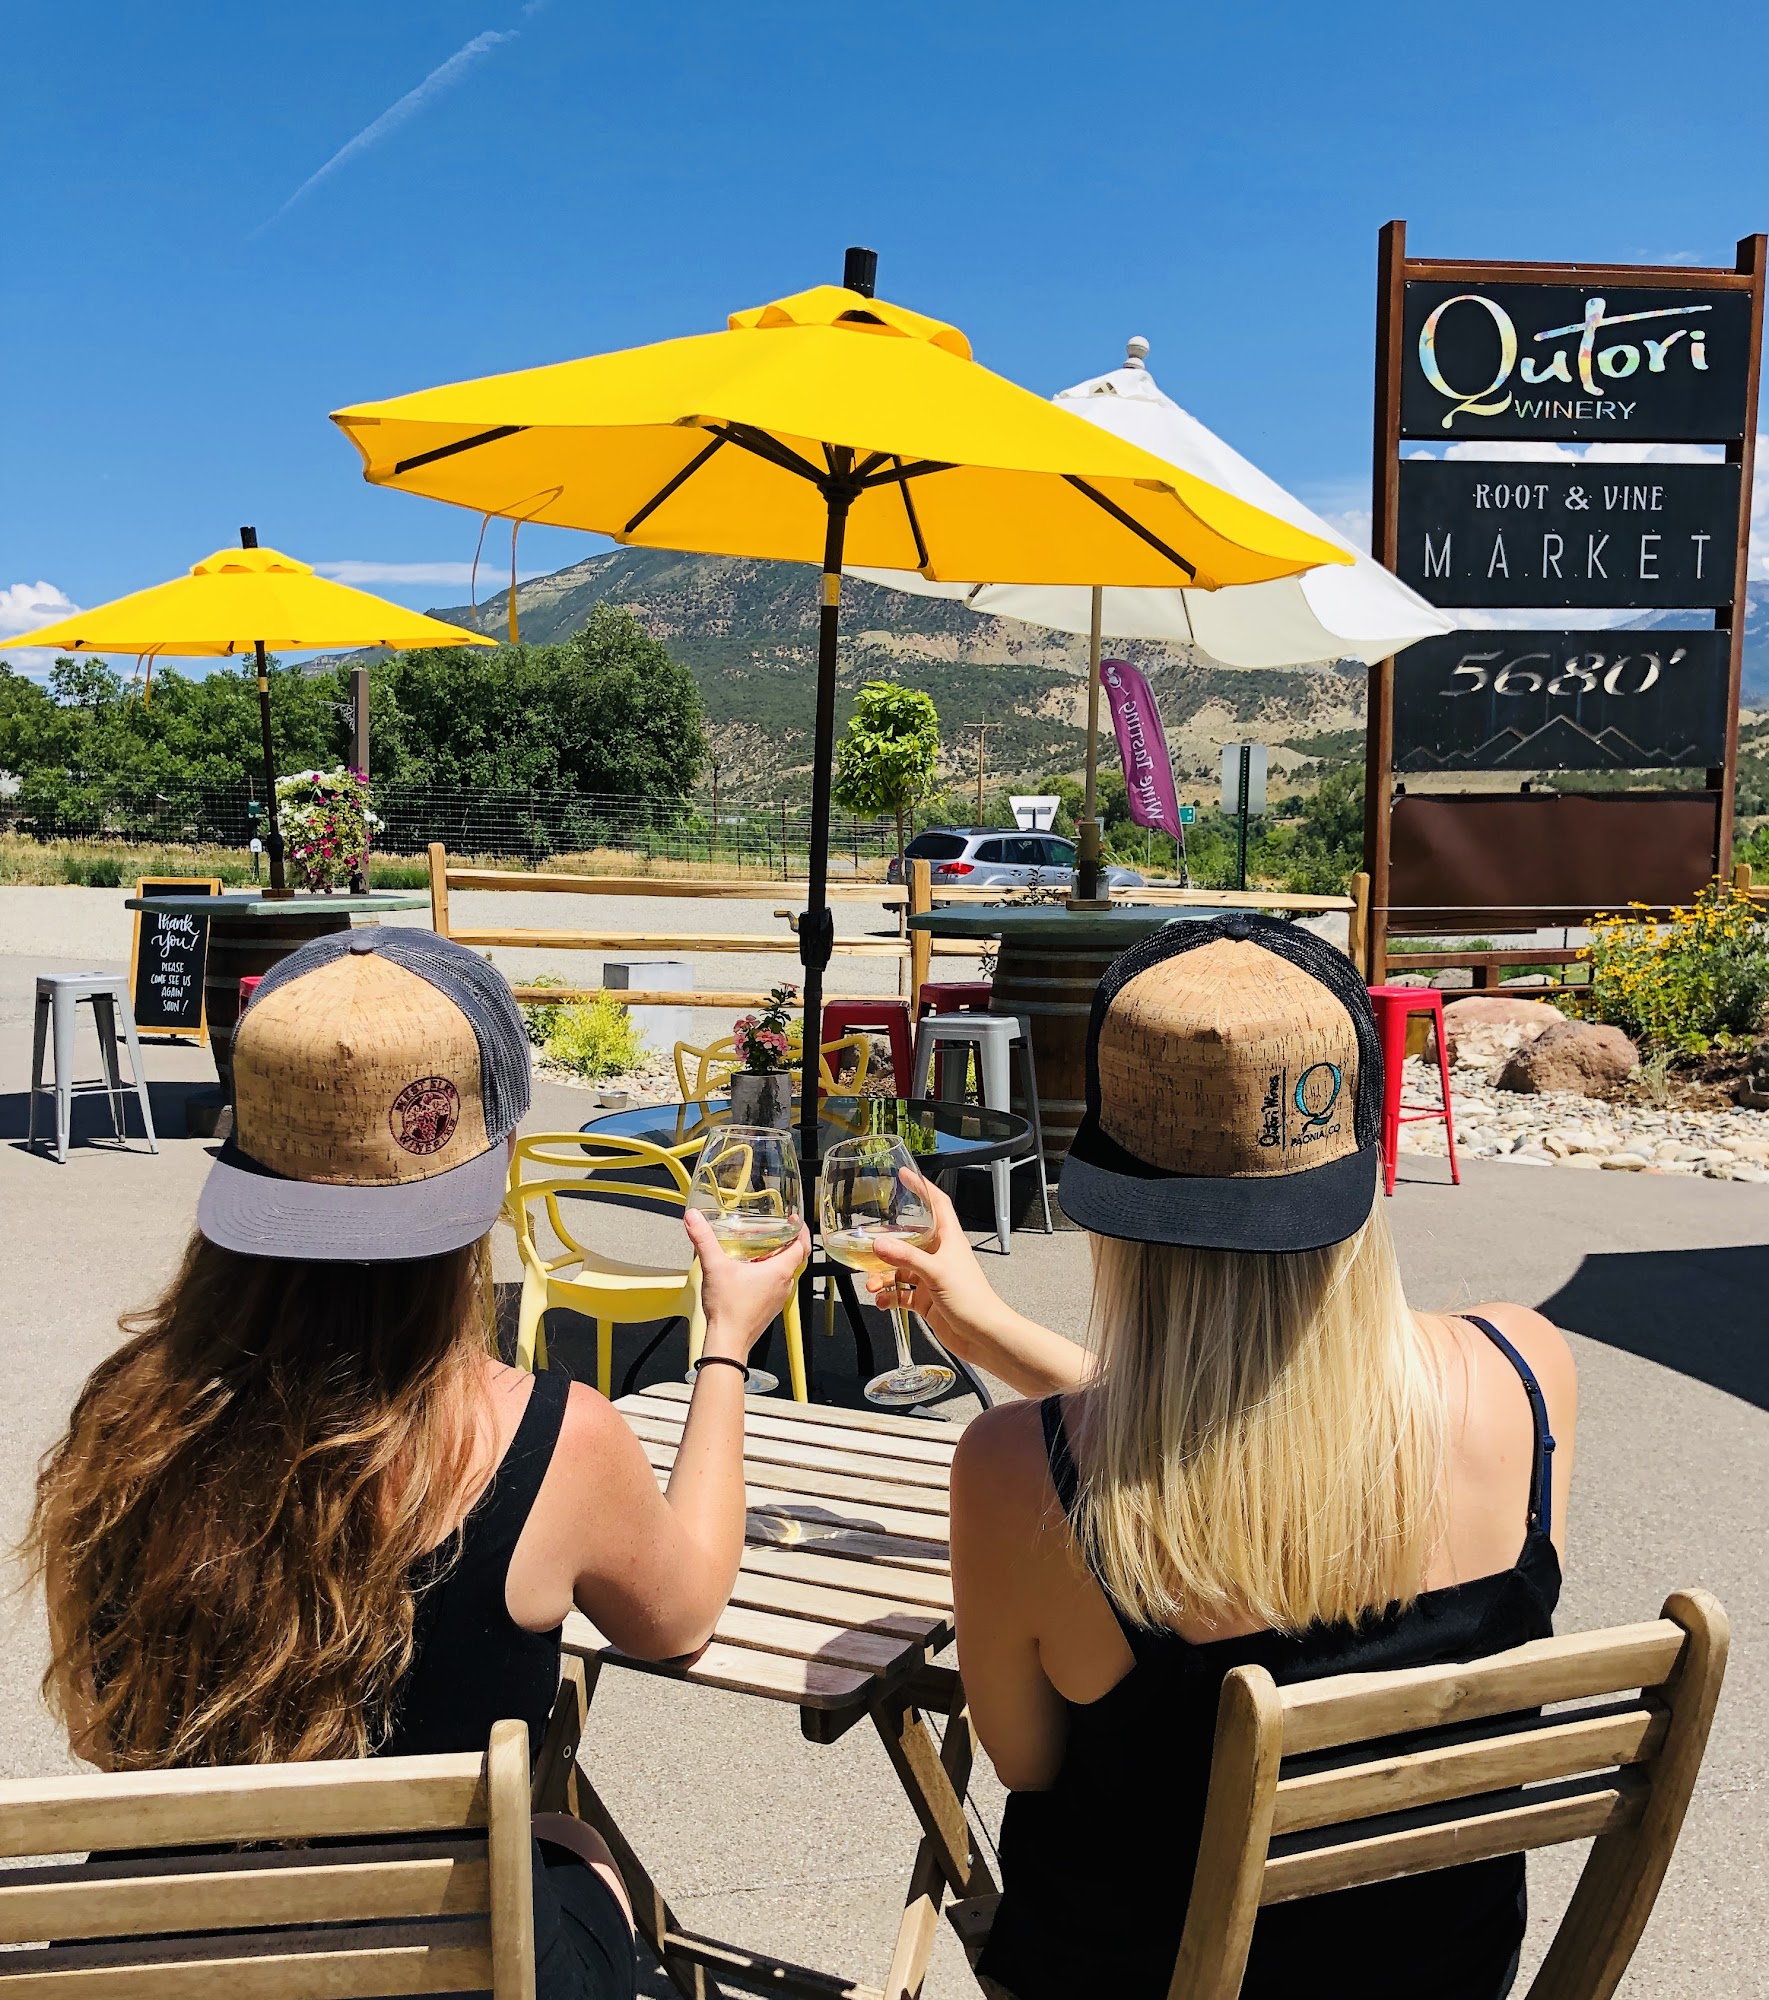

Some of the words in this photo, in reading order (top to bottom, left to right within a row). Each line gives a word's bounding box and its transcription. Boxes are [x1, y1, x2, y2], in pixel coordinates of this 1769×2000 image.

[1418, 294, 1713, 429] Qutori
[1514, 400, 1637, 420] WINERY
[1474, 484, 1549, 511] ROOT
[1564, 486, 1591, 511] &
[1603, 485, 1664, 511] VINE
[1423, 532, 1712, 580] MARKET
[161, 962, 185, 973] PLEASE
[150, 974, 167, 985] COME
[168, 974, 180, 985] SEE
[182, 974, 192, 987] US
[161, 986, 184, 998] AGAIN
[1295, 1062, 1341, 1134] Q
